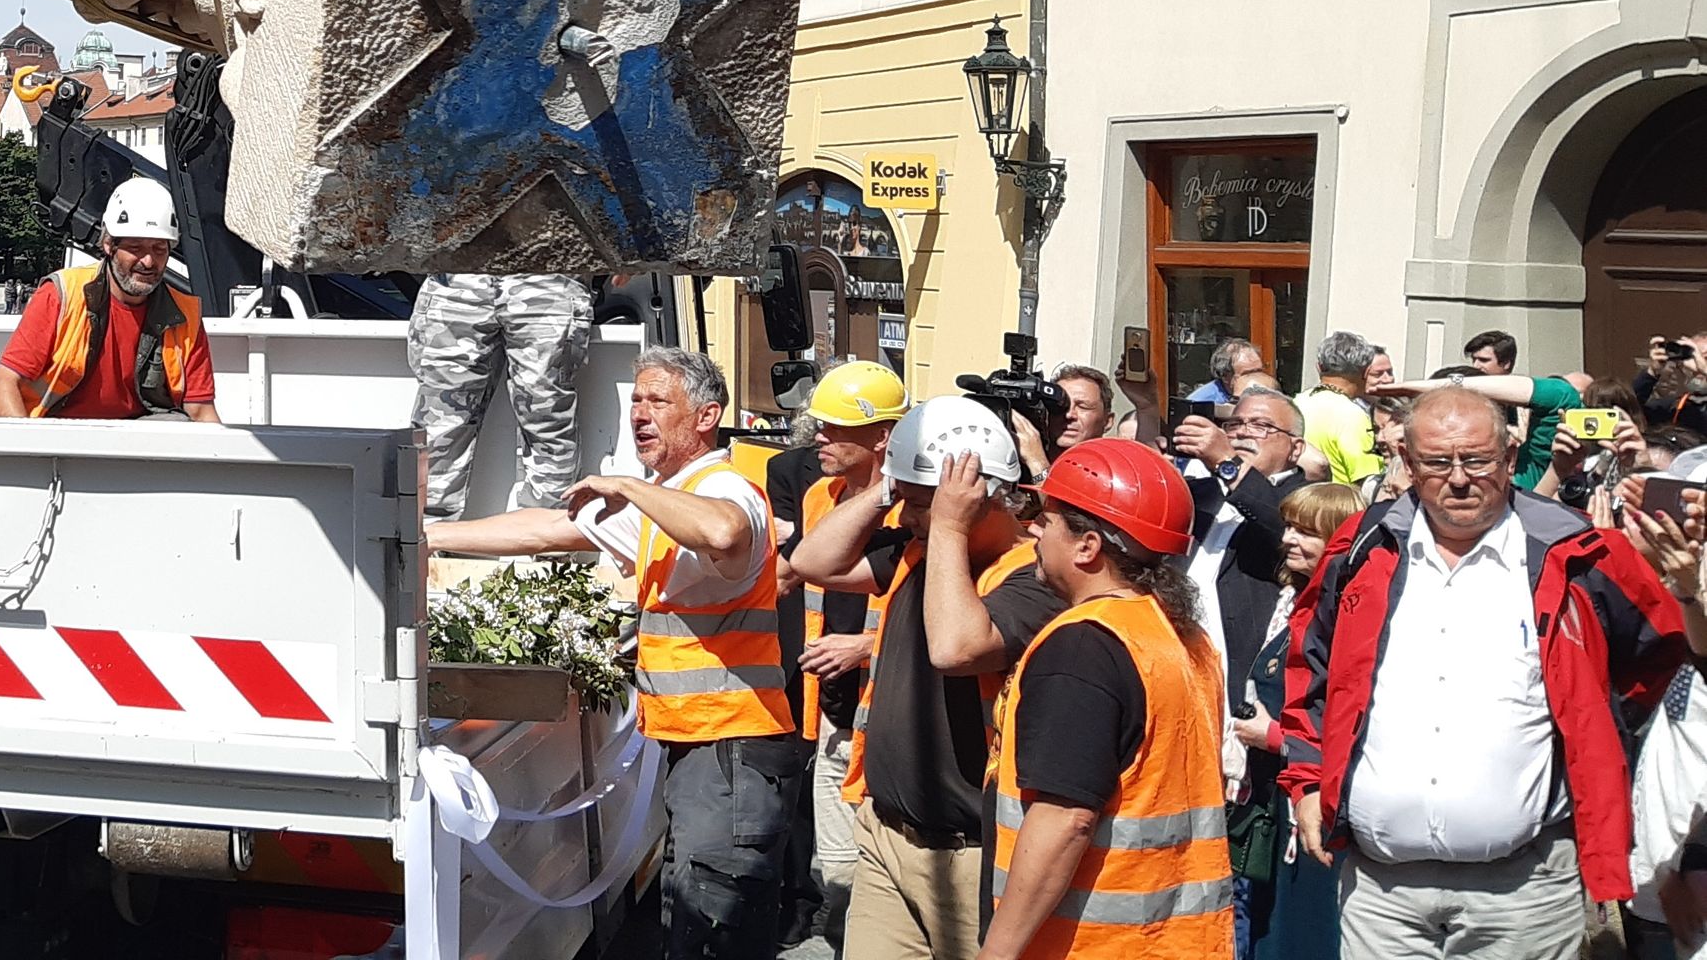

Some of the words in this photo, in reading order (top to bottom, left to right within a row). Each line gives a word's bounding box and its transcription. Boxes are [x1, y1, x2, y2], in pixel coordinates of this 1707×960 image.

[871, 161, 929, 179] Kodak
[871, 182, 930, 200] Express
[1182, 169, 1260, 208] Bohemia
[883, 321, 906, 340] ATM
